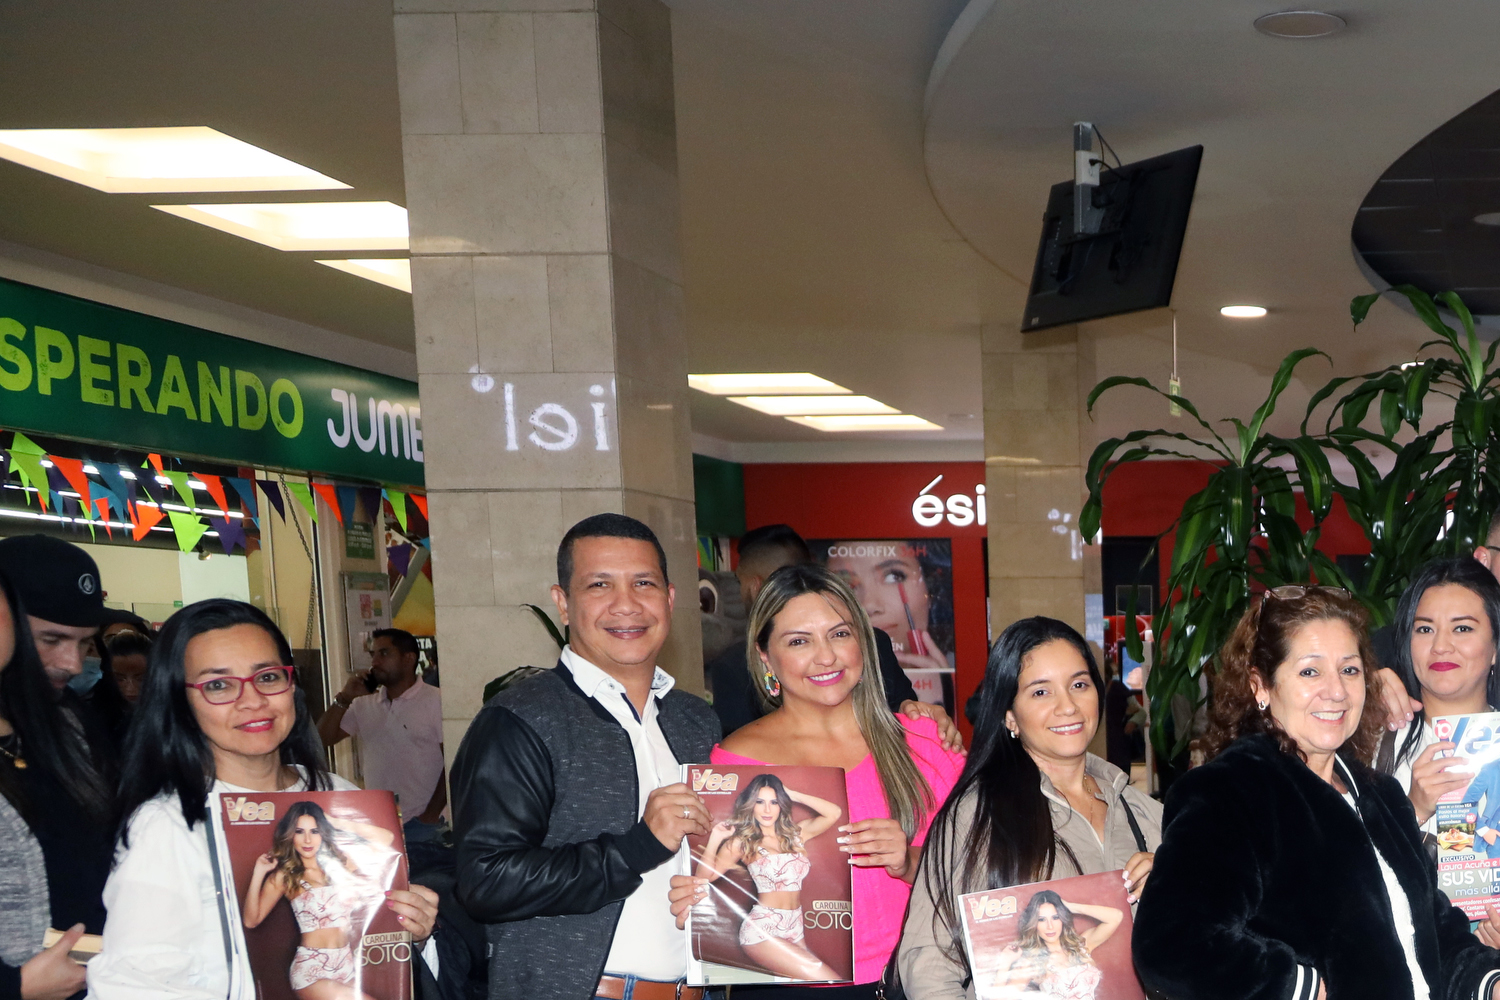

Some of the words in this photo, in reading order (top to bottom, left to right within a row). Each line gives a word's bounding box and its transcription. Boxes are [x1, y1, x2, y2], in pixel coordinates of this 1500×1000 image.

[0, 317, 304, 438] SPERANDO
[912, 474, 986, 527] ési
[828, 546, 896, 557] COLORFIX
[692, 769, 738, 791] Vea
[224, 796, 275, 821] Vea
[1464, 860, 1490, 869] Acuña
[1442, 870, 1474, 886] SUS
[1455, 886, 1478, 896] más
[1482, 883, 1500, 894] allá
[814, 902, 848, 910] CAROLINA
[968, 896, 1017, 920] Vea
[804, 911, 852, 930] SOTO
[365, 933, 403, 945] CAROLINA
[354, 942, 412, 967] SOTO
